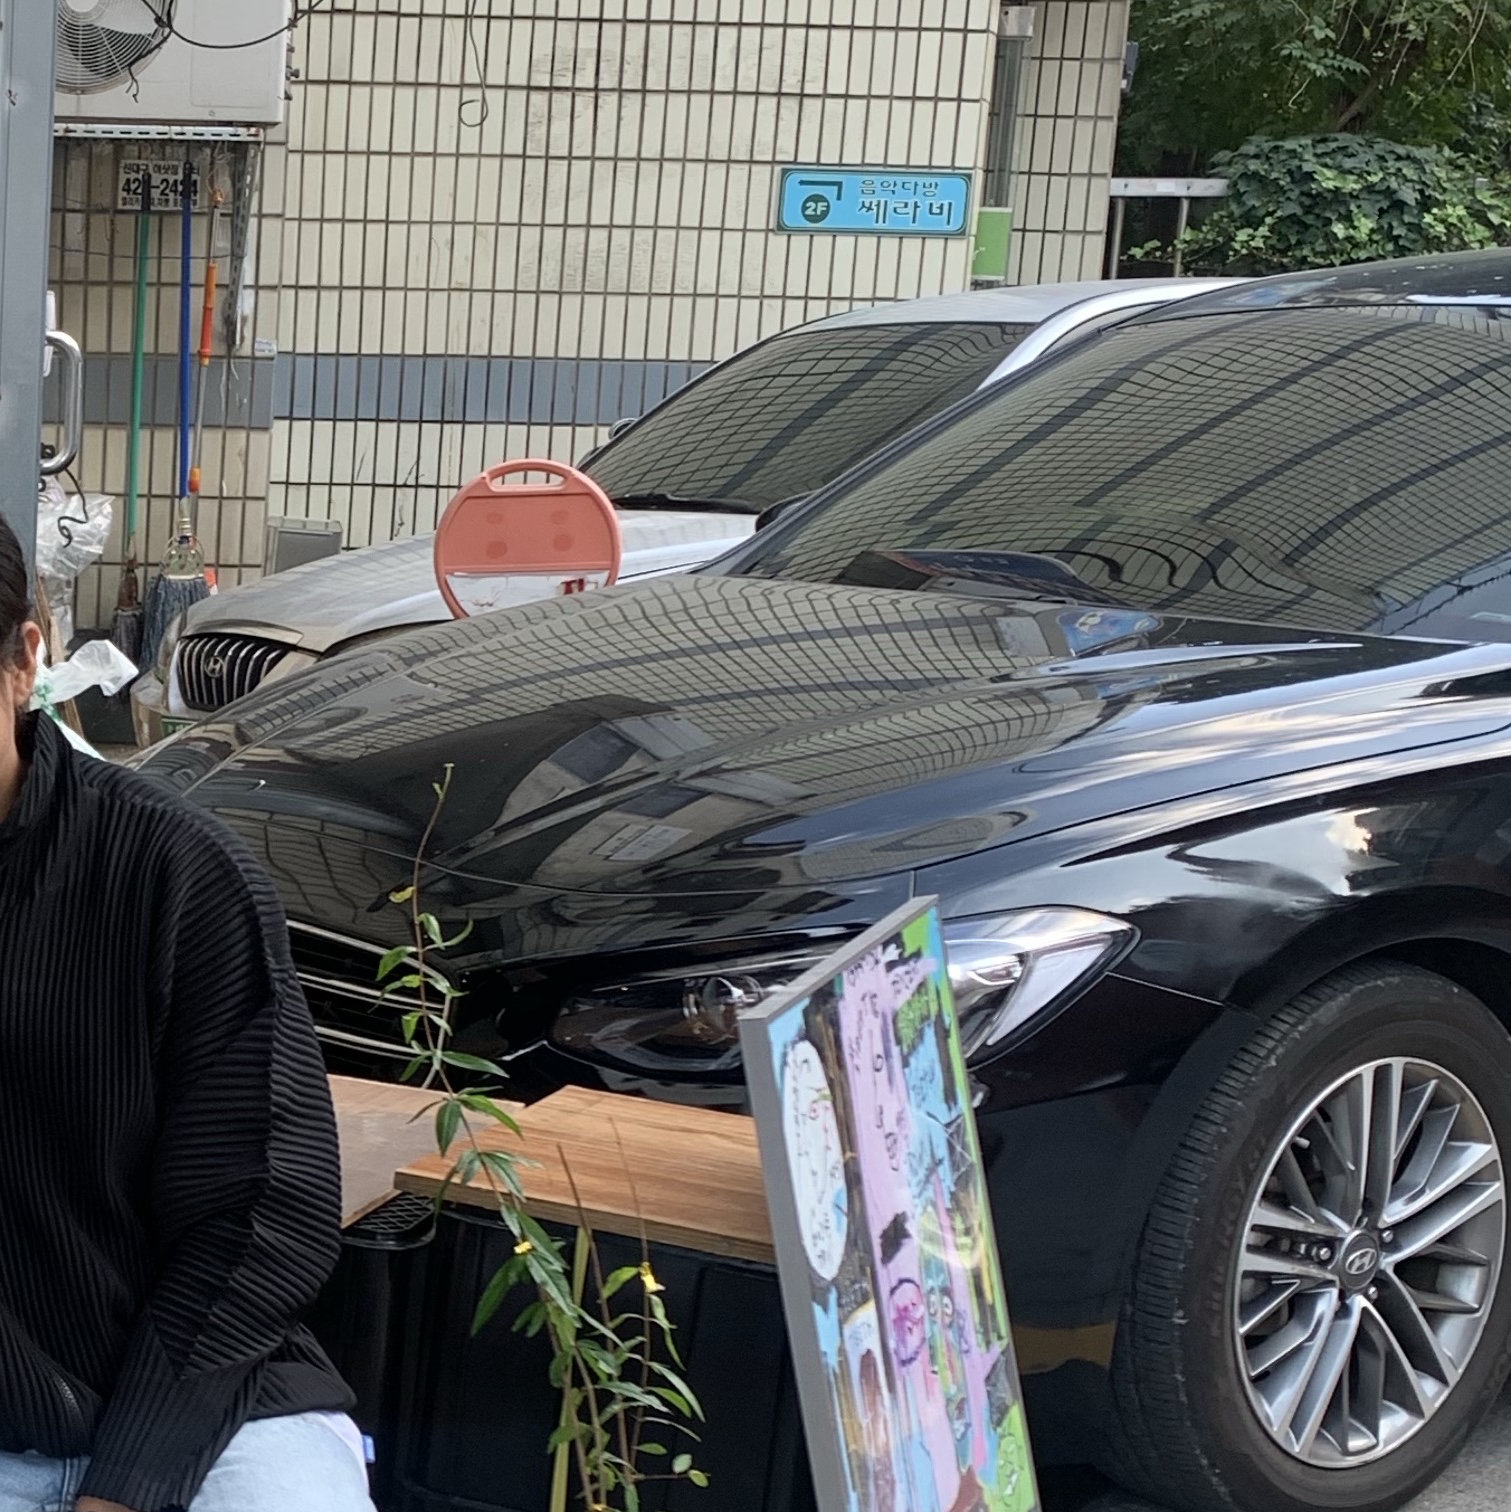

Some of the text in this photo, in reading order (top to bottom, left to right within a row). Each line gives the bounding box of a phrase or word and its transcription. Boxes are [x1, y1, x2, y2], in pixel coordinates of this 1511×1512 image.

[122, 177, 199, 197] 42-244
[859, 179, 939, 197] 음악다방
[804, 201, 828, 216] 2F
[857, 199, 953, 227] 쎄라비
